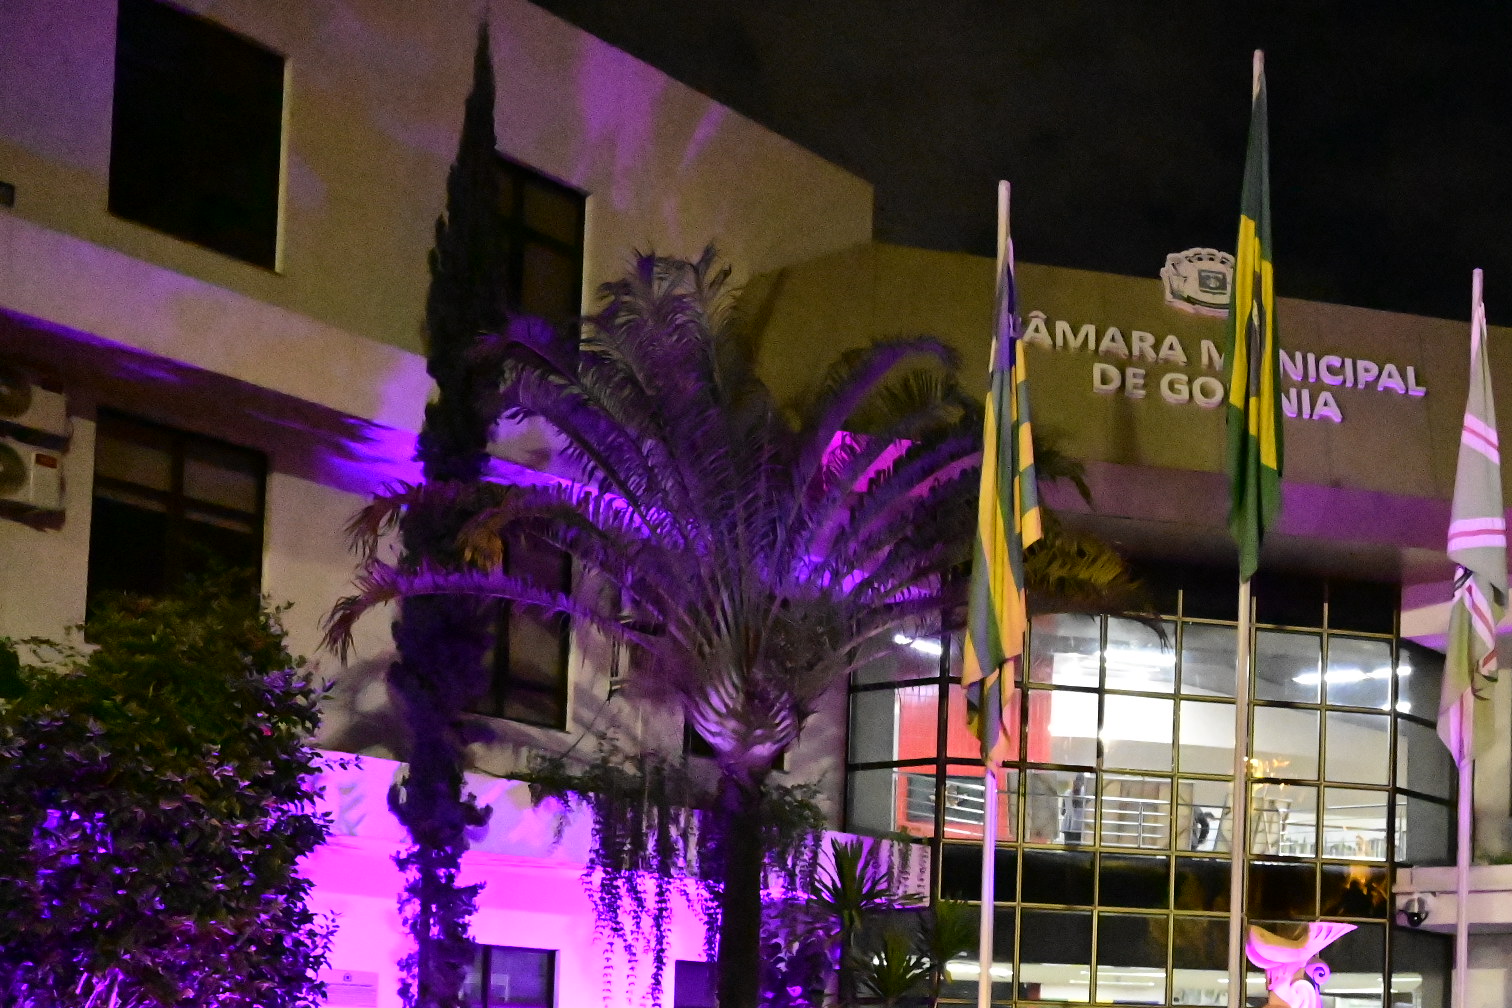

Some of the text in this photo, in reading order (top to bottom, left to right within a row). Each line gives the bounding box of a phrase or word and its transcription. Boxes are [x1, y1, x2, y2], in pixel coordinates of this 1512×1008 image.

[1019, 310, 1427, 397] ÂMARA MNICIPAL
[1092, 362, 1343, 423] DE GONIA
